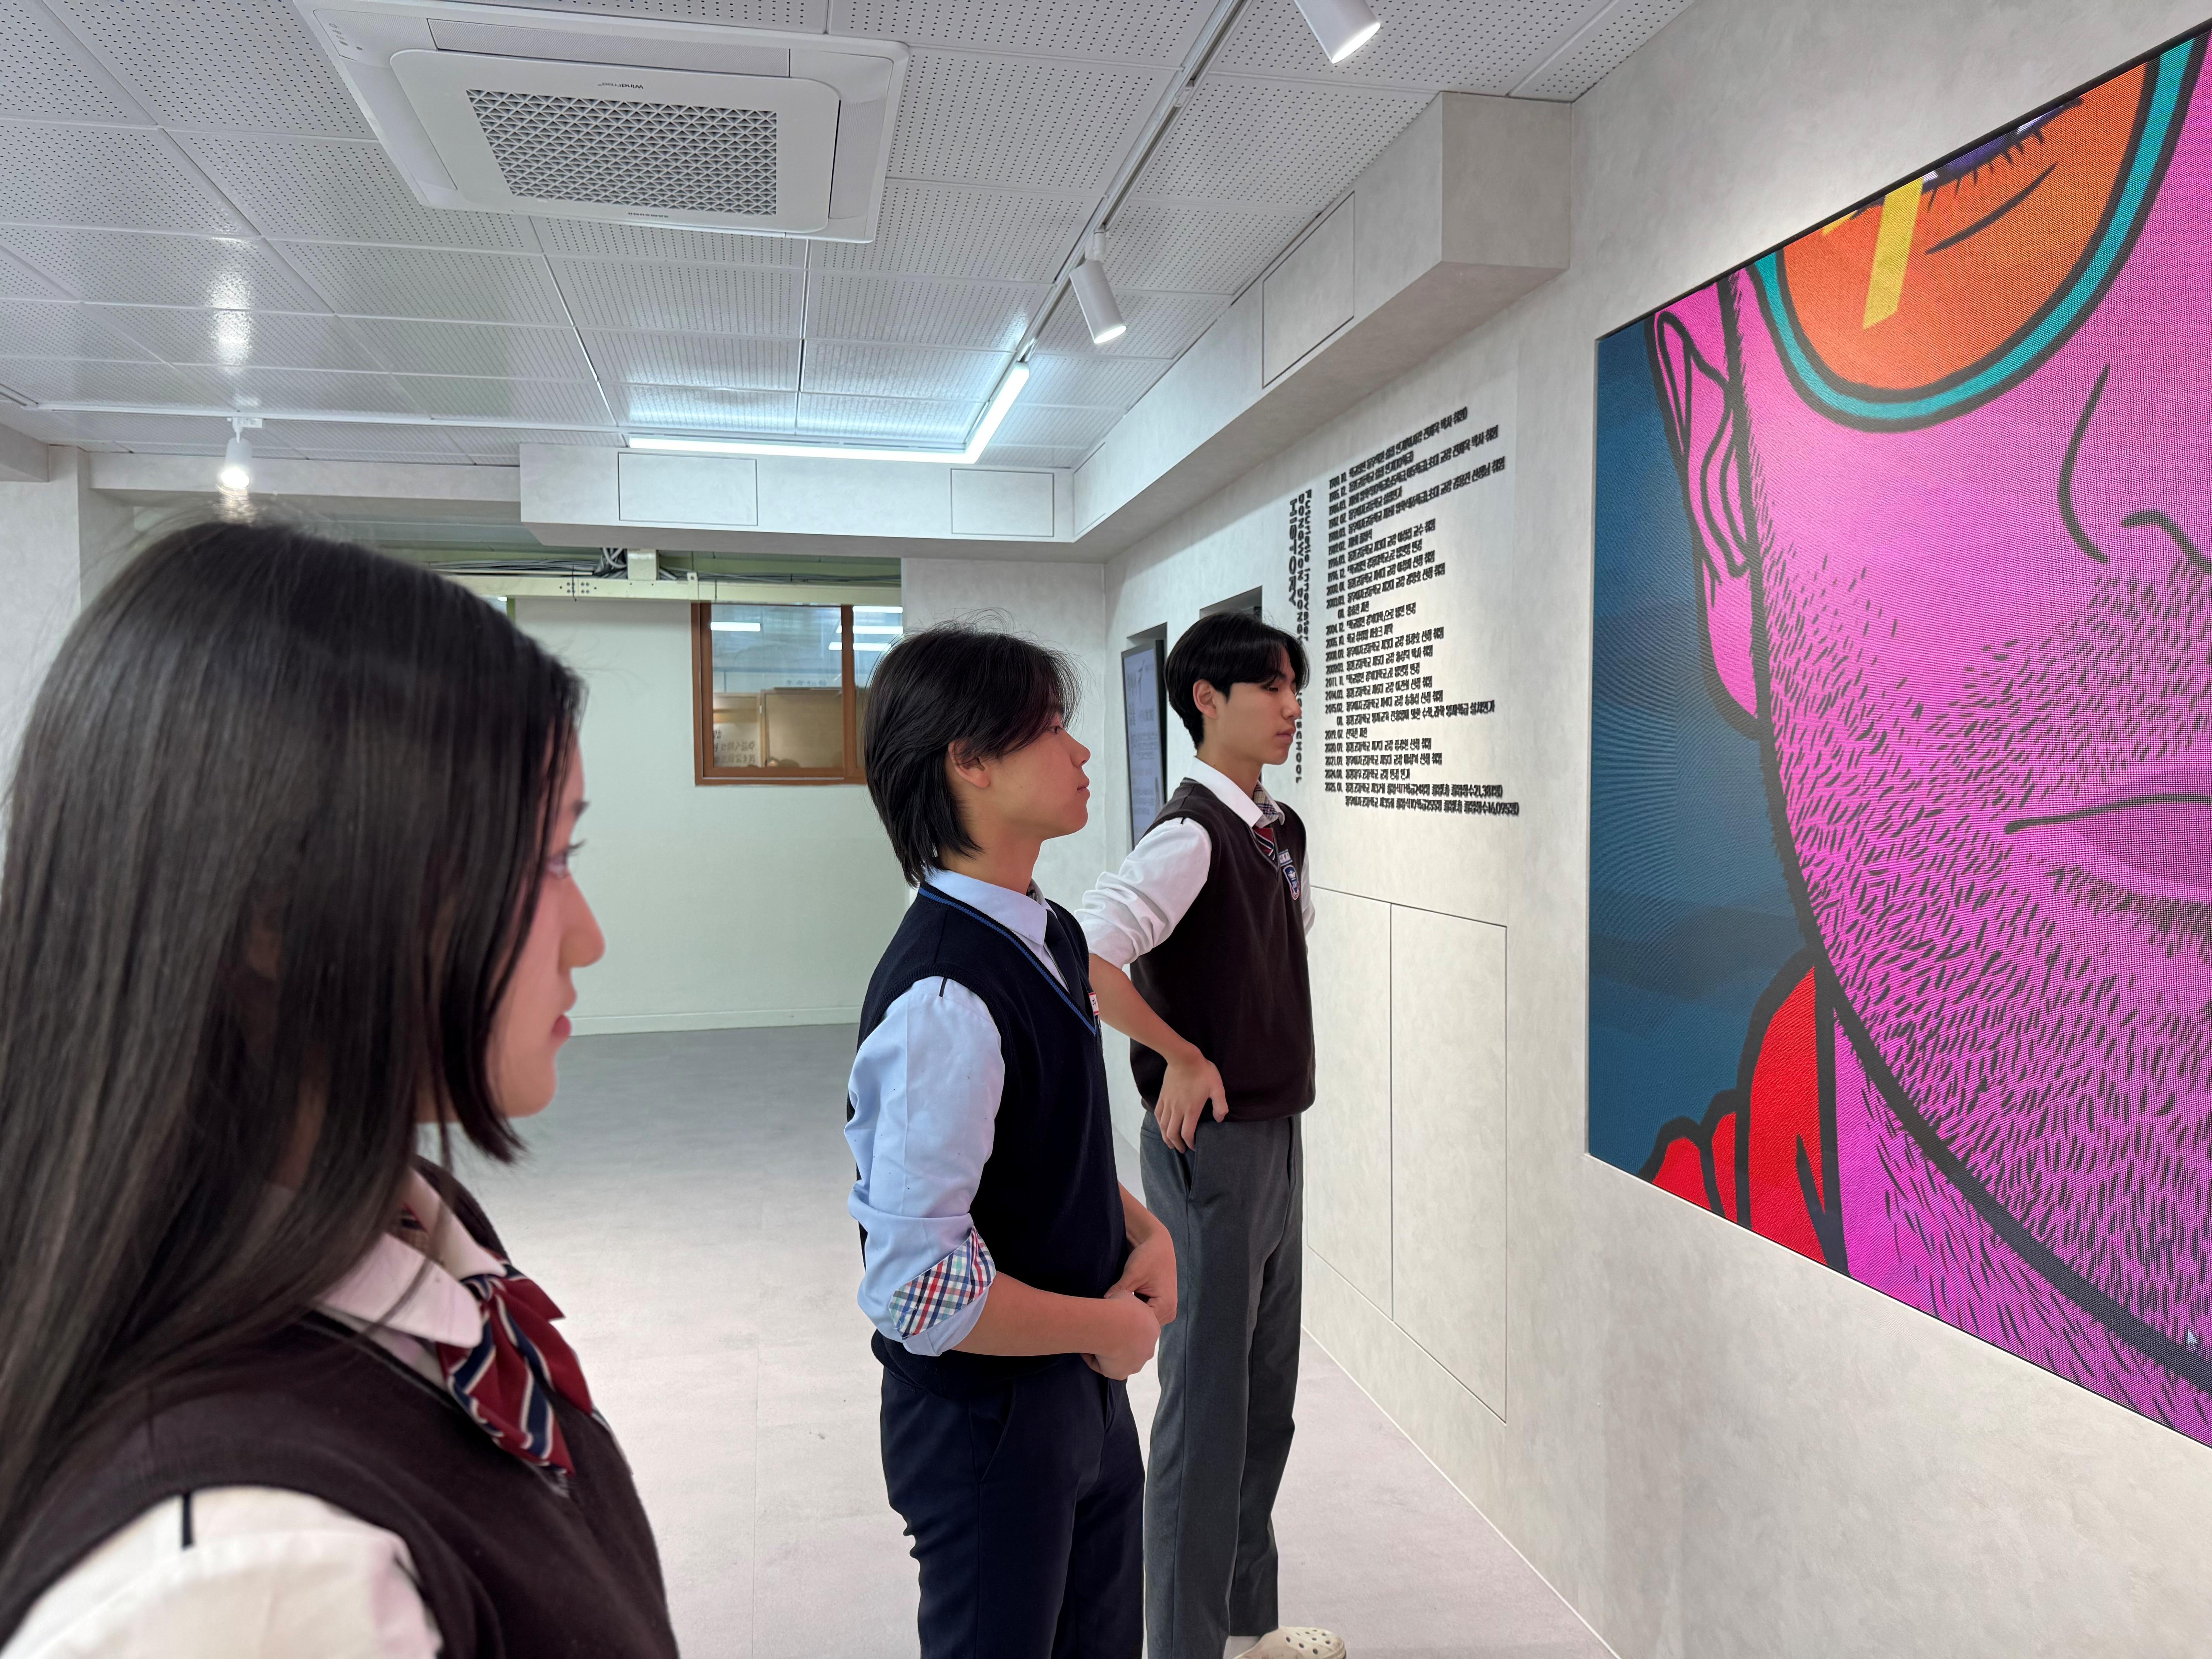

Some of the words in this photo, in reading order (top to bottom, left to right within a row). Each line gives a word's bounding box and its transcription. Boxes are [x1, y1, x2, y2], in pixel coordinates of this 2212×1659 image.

[1439, 447, 1452, 464] 교장
[1485, 424, 1499, 442] 취임
[1348, 471, 1375, 493] 동원고등학교
[1348, 510, 1382, 534] 동우여자고등학교
[1440, 479, 1453, 495] 교장
[1491, 456, 1505, 474] 취임
[1348, 496, 1383, 521] 동우여자고등학교
[1288, 498, 1298, 606] HISTORY
[1348, 543, 1373, 563] 동원고등학교
[1387, 533, 1397, 548] 교장
[1424, 518, 1436, 533] 취임
[1412, 538, 1422, 553] 변경
[1347, 572, 1373, 590] 동원고등학교
[1386, 563, 1396, 577] 교장
[1424, 550, 1435, 565] 취임
[1347, 583, 1381, 603] 동우여자고등학교
[1395, 575, 1405, 589] 교장
[1434, 562, 1446, 577] 취임
[1406, 602, 1416, 616] 변경
[1346, 641, 1380, 658] 동우여자고등학교
[1395, 635, 1404, 648] 교장
[1433, 626, 1444, 640] 취임
[1346, 657, 1371, 672] 동원고등학교
[1385, 652, 1395, 665] 교장
[1422, 644, 1433, 657] 취임
[1410, 662, 1420, 675] 변경
[1346, 685, 1371, 699] 동원고등학교
[1385, 681, 1395, 693] 교장
[1422, 675, 1432, 688] 취임
[1346, 698, 1379, 712] 동우여자고등학교
[1394, 694, 1403, 707] 교장
[1432, 690, 1443, 702] 취임
[1346, 713, 1370, 726] 동원고등학교
[1346, 741, 1370, 753] 동원고등학교
[1384, 739, 1393, 751] 교장
[1421, 737, 1432, 750] 취임
[1345, 755, 1379, 766] 동우여자고등학교
[1393, 754, 1403, 766] 교장
[1431, 752, 1443, 766] 취임
[1345, 782, 1370, 793] 동원고등학교
[1345, 795, 1378, 808] 동우여자고등학교
